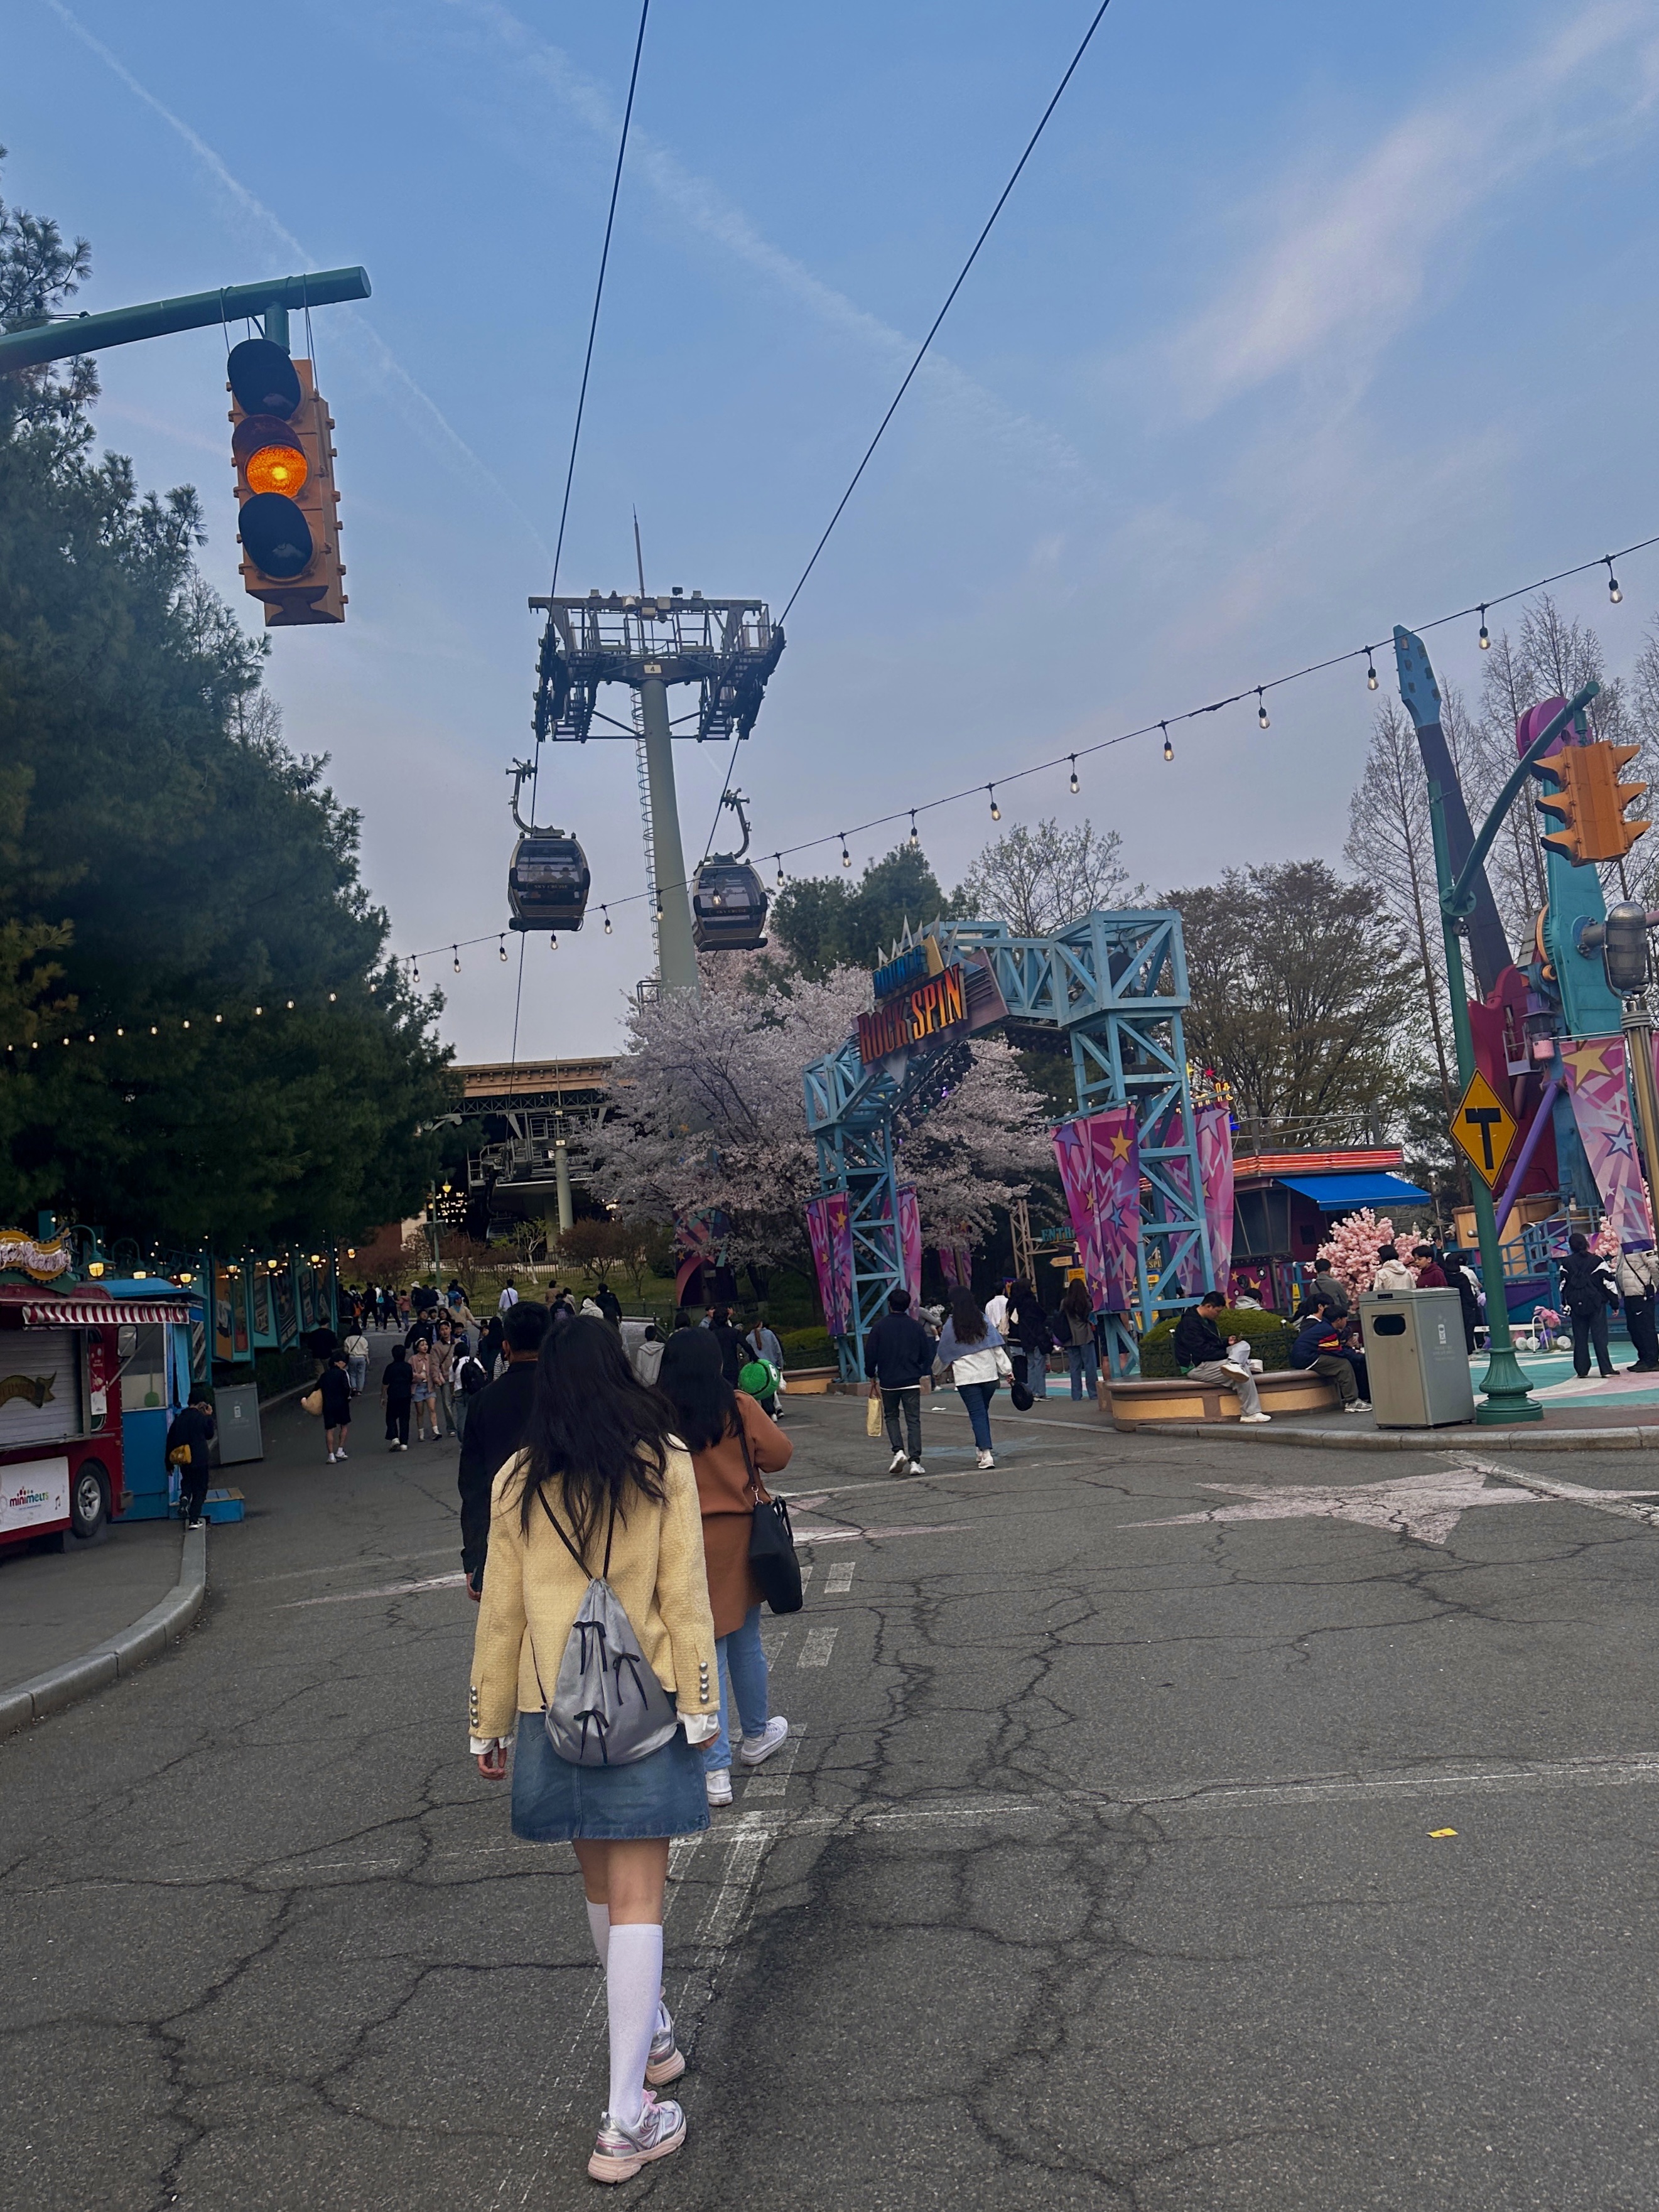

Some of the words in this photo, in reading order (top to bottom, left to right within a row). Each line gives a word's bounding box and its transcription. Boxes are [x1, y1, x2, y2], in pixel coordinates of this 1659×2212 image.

[872, 944, 929, 1000] DOUBLE
[857, 998, 911, 1064] ROCK
[911, 963, 964, 1040] SPIN
